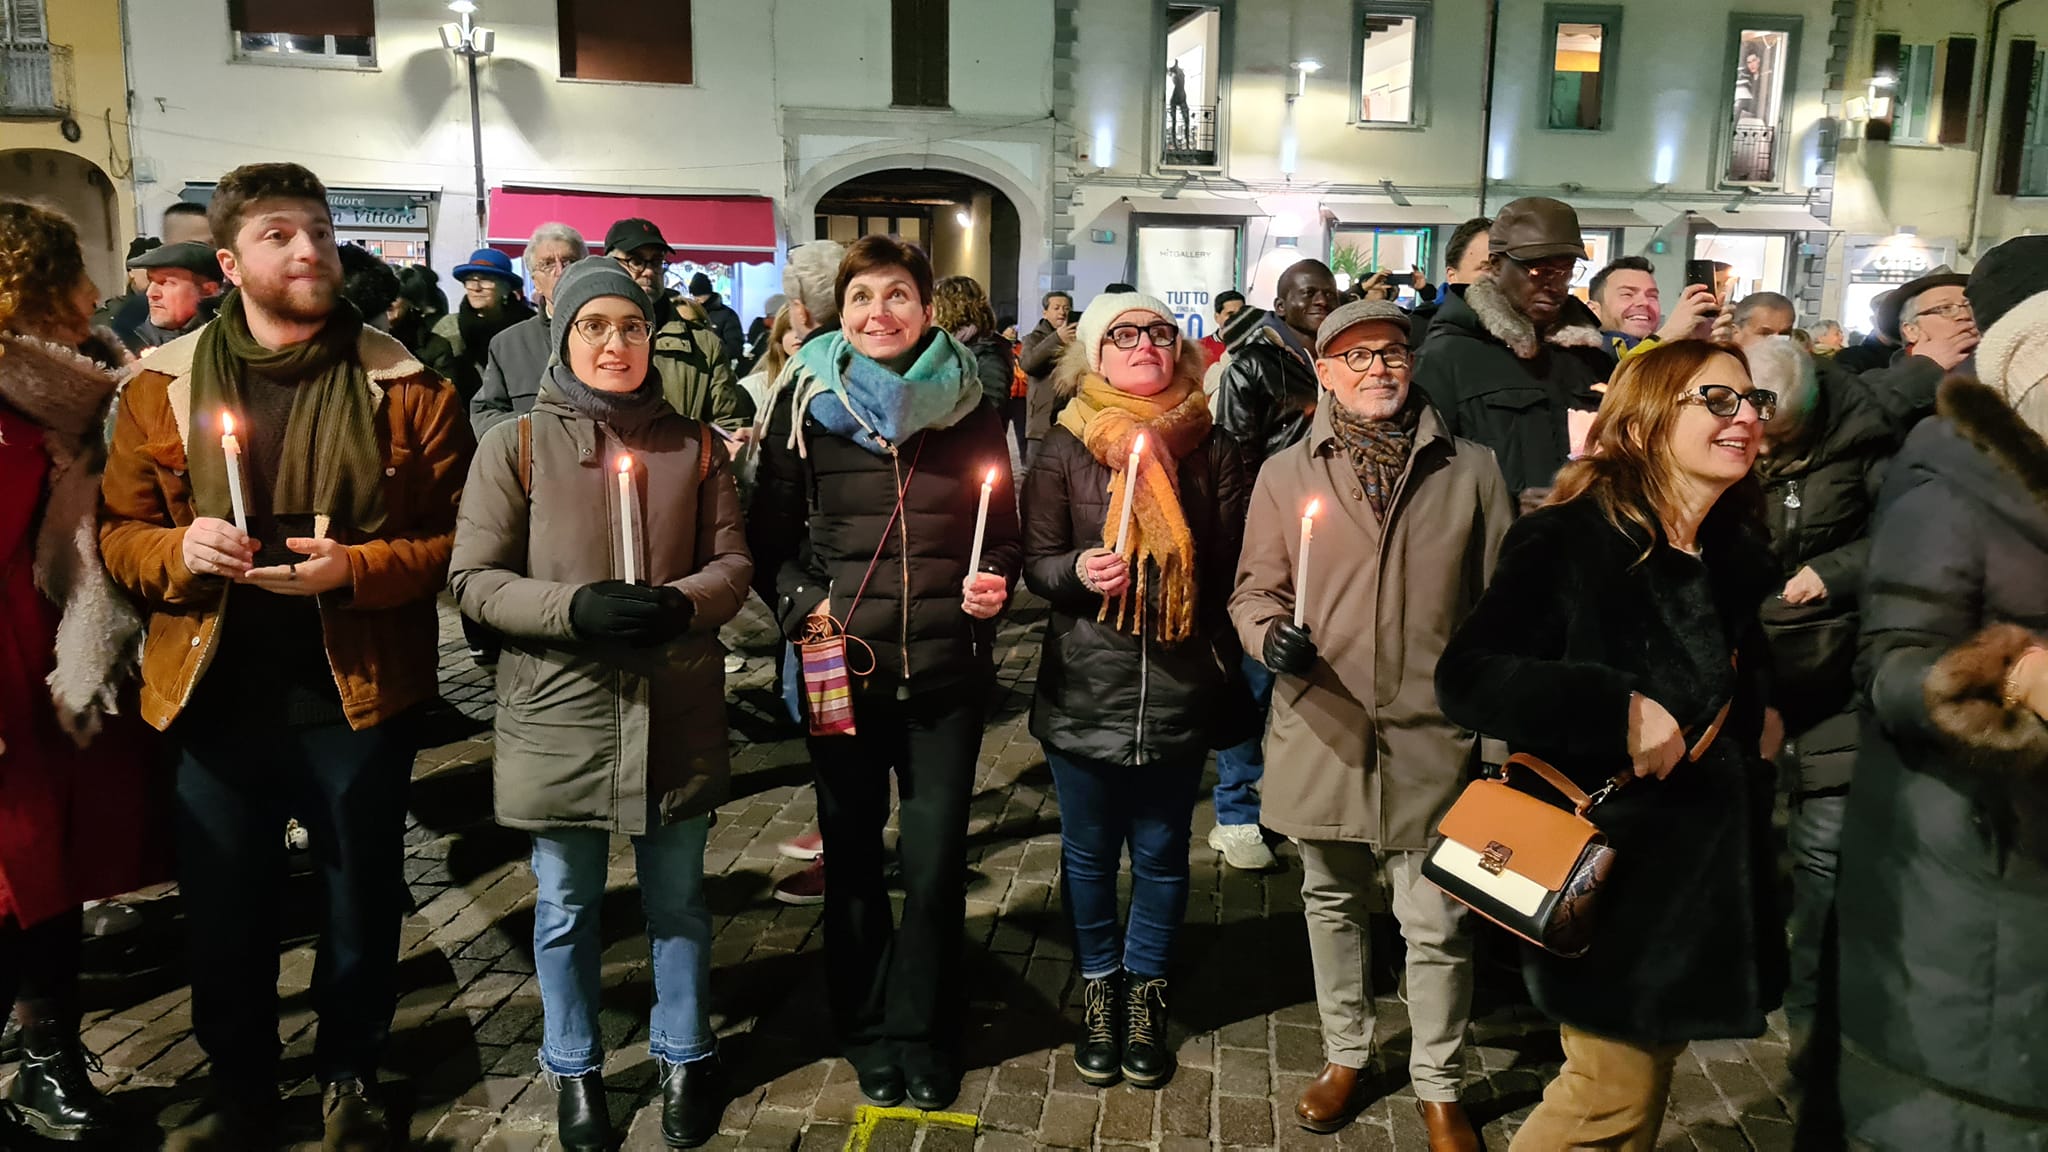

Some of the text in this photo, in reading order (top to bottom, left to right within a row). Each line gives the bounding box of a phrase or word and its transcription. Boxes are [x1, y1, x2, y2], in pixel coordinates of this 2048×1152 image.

[328, 195, 365, 206] ittore
[354, 210, 416, 224] Vittore
[1166, 291, 1209, 305] TUTTO
